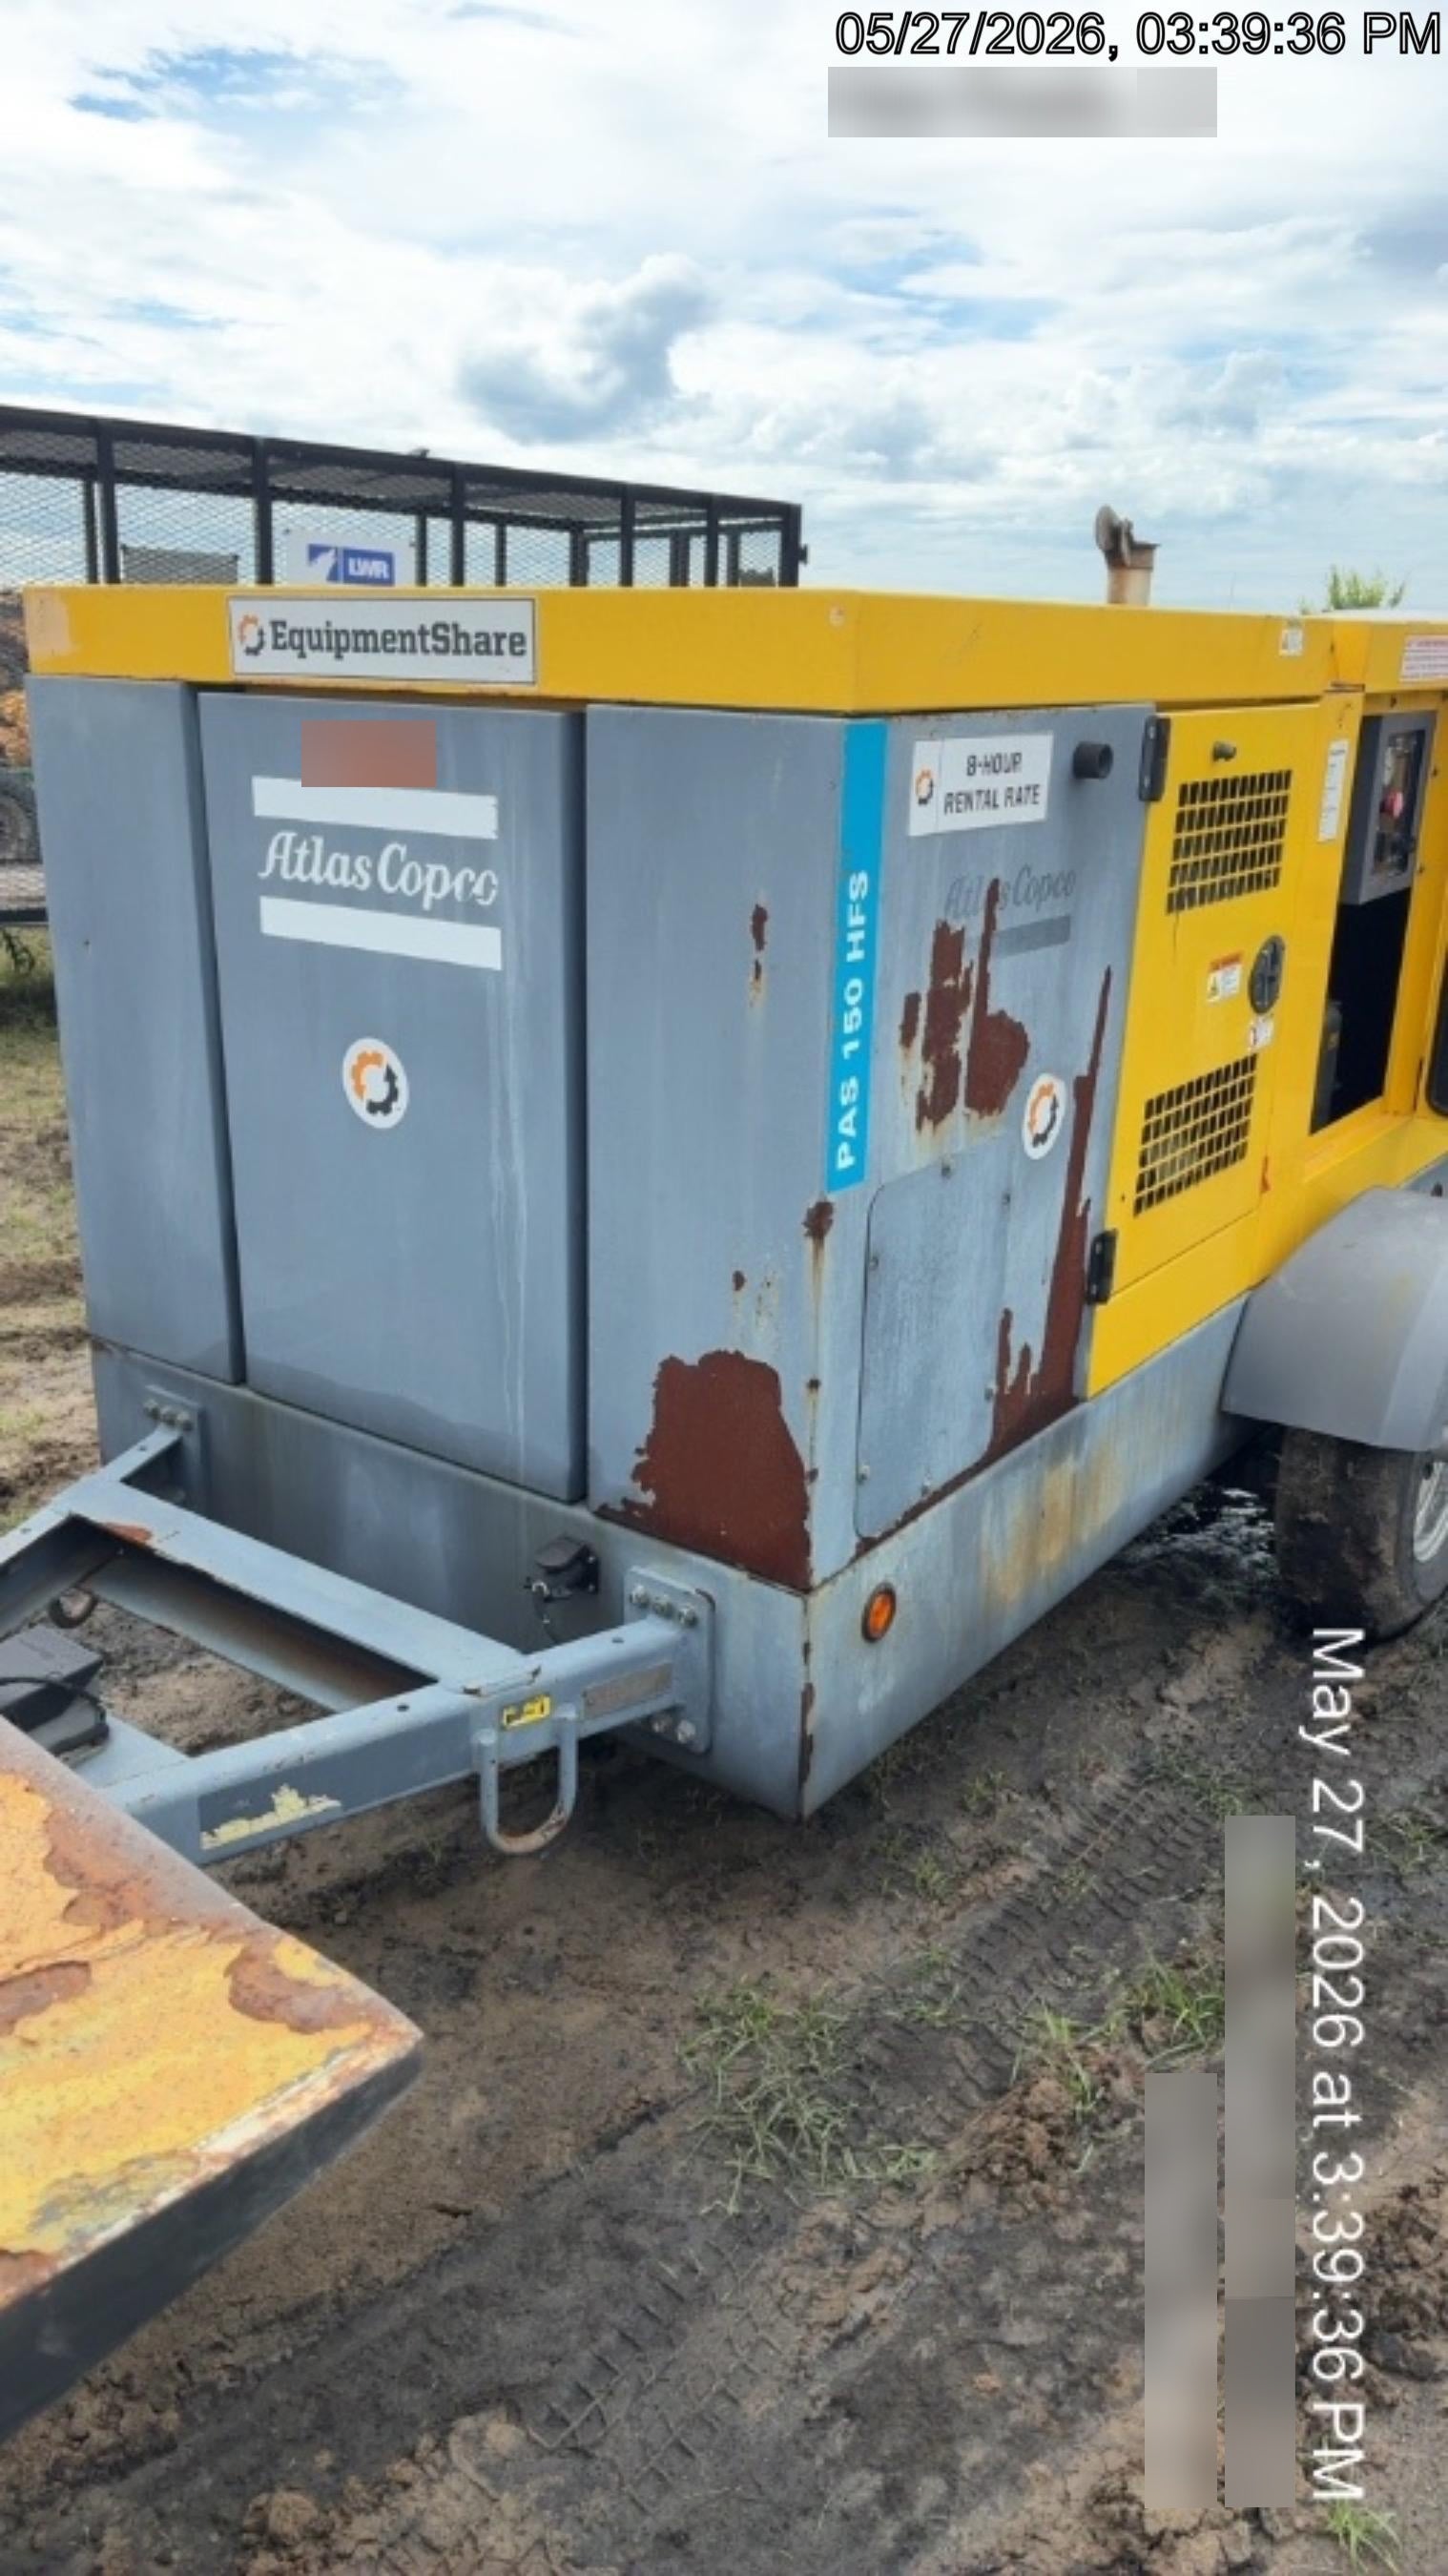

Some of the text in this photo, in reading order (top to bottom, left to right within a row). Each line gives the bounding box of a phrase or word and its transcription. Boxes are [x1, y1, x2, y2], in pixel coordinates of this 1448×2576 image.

[269, 620, 527, 659] EquipmentShare
[966, 753, 1023, 777] 8-HOUR
[944, 783, 1041, 815] RENTAL RATE
[258, 830, 498, 910] Atlas Copco
[945, 875, 1011, 918] Atls
[836, 869, 869, 1170] PAS 150 HFS
